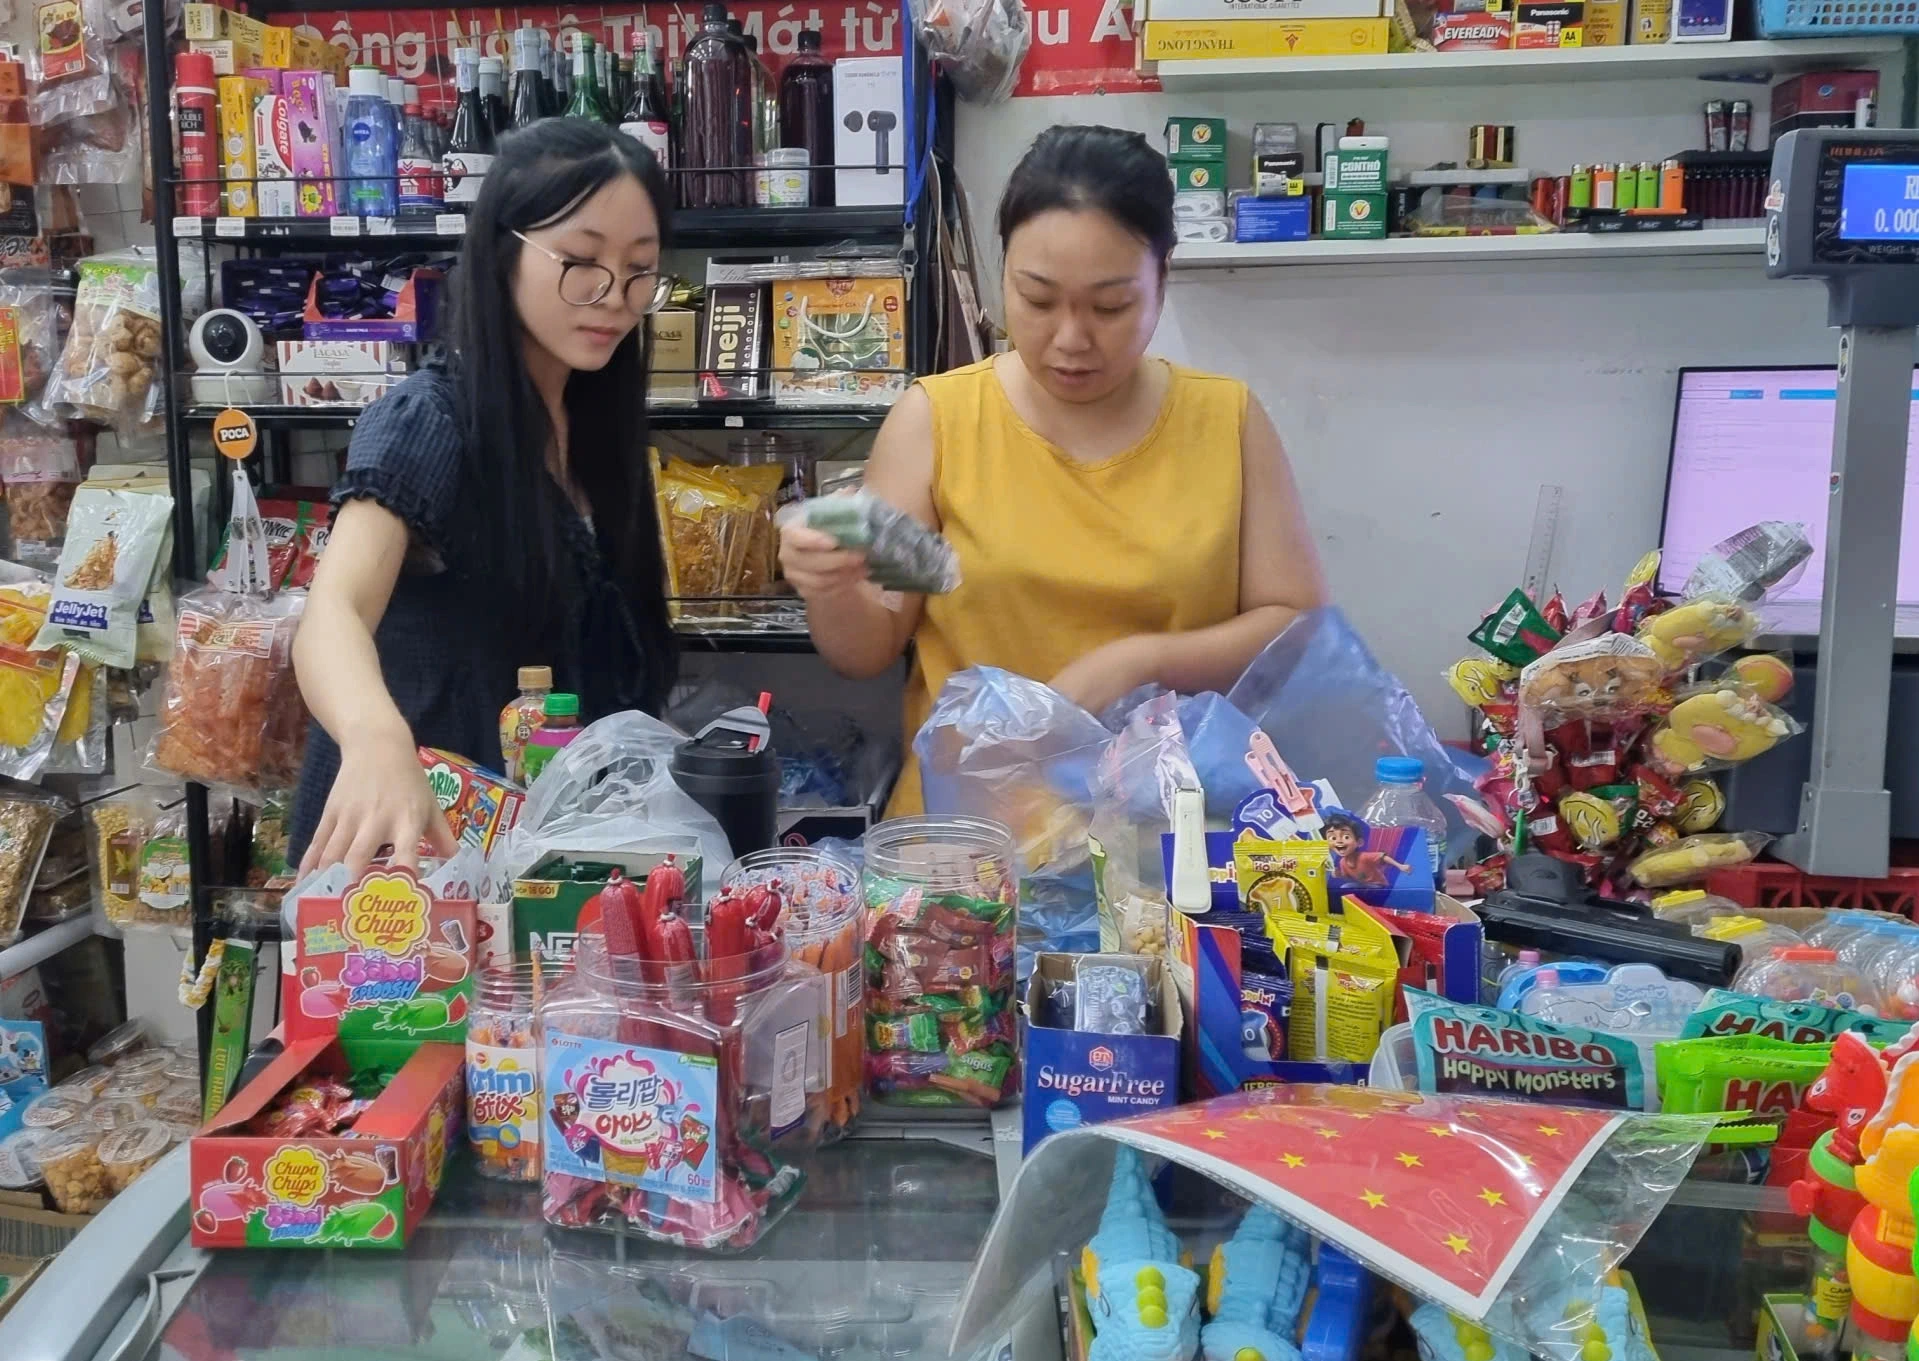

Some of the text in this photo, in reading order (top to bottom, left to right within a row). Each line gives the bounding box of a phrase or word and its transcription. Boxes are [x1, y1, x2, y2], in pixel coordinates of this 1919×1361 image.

[1530, 9, 1569, 17] Panasonic
[841, 1, 900, 52] từ
[1444, 26, 1502, 39] EVEREADY
[1565, 33, 1575, 41] AA
[277, 98, 289, 154] Colgate
[1868, 244, 1905, 254] WEIGHT
[743, 292, 757, 360] chocolate
[714, 305, 747, 378] meiji
[219, 427, 250, 442] POCA
[55, 602, 105, 618] JellyJet
[1256, 809, 1274, 823] 10
[358, 894, 418, 919] Chupa
[354, 914, 416, 945] Chups
[350, 980, 418, 1002] SPLOOSH
[560, 1041, 583, 1049] LOTTE
[1433, 1018, 1617, 1067] HARIBO
[961, 1055, 993, 1072] sugus
[1443, 1057, 1616, 1095] Happy Monsters
[586, 1073, 662, 1108] 롤리팝
[1107, 1096, 1160, 1105] MINT CANDY
[595, 1110, 653, 1139] 아이스
[274, 1161, 320, 1179] Chupa
[687, 1173, 701, 1186] 60
[272, 1176, 317, 1200] Chups
